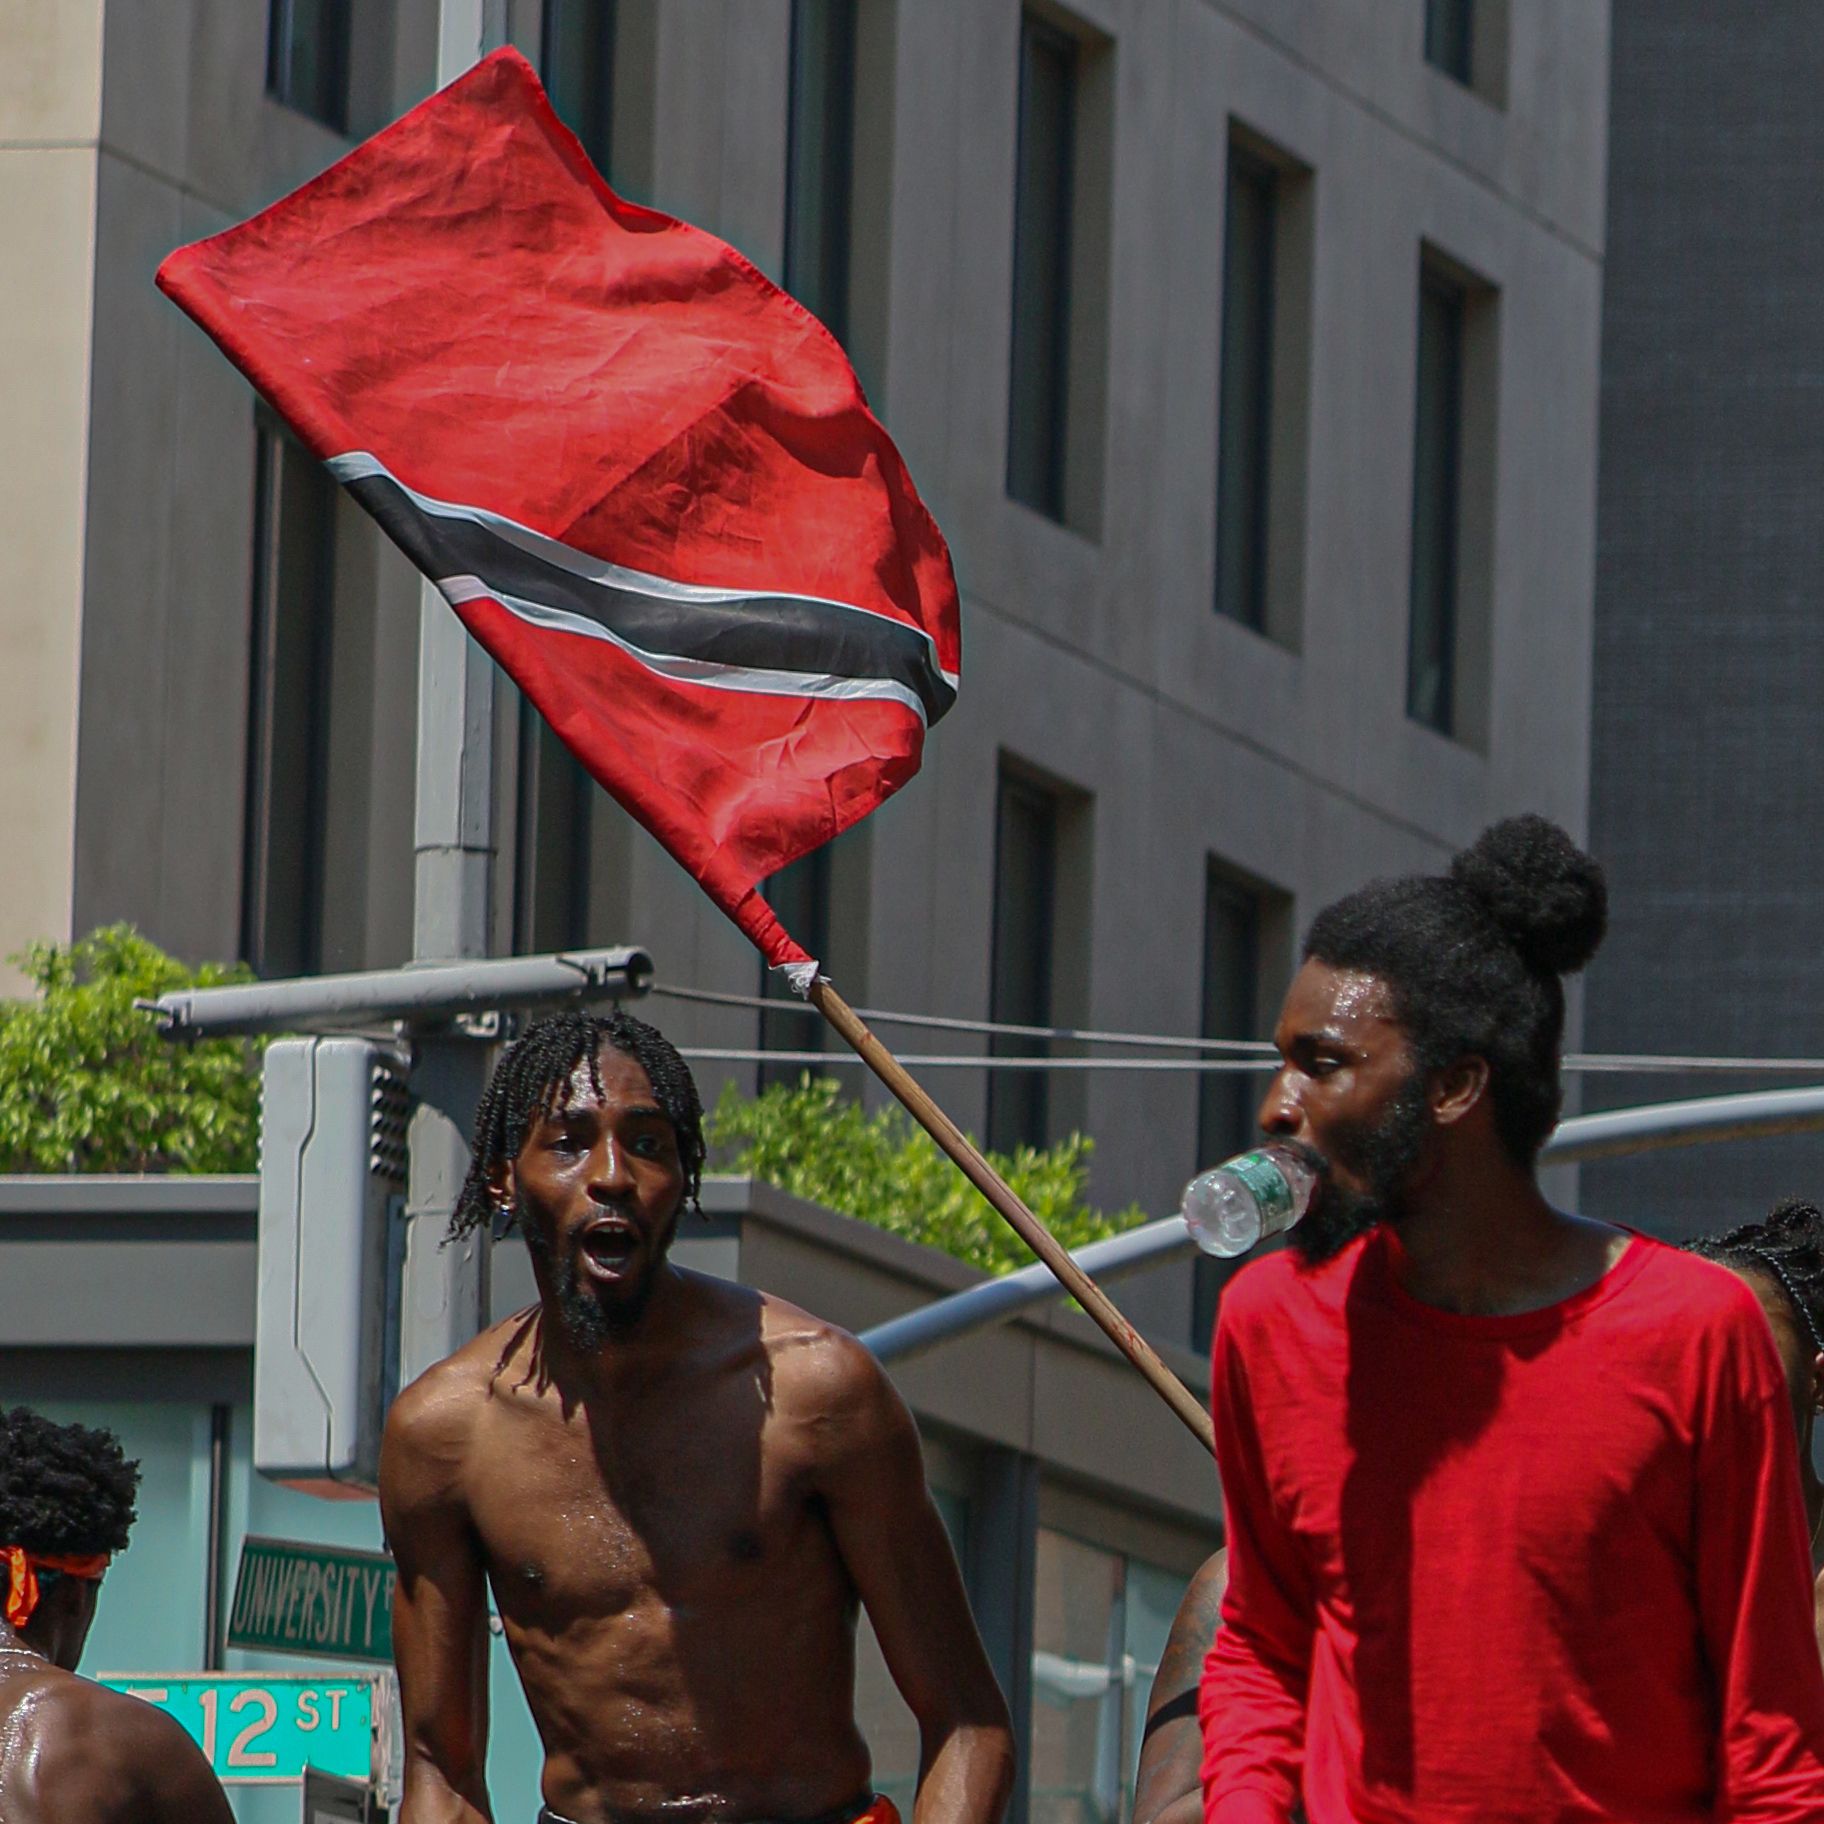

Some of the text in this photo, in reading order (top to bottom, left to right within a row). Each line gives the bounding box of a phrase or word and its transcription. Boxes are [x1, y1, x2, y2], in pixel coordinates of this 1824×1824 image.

[233, 1552, 381, 1648] UNIVERSITY
[199, 1688, 348, 1767] 12 ST
